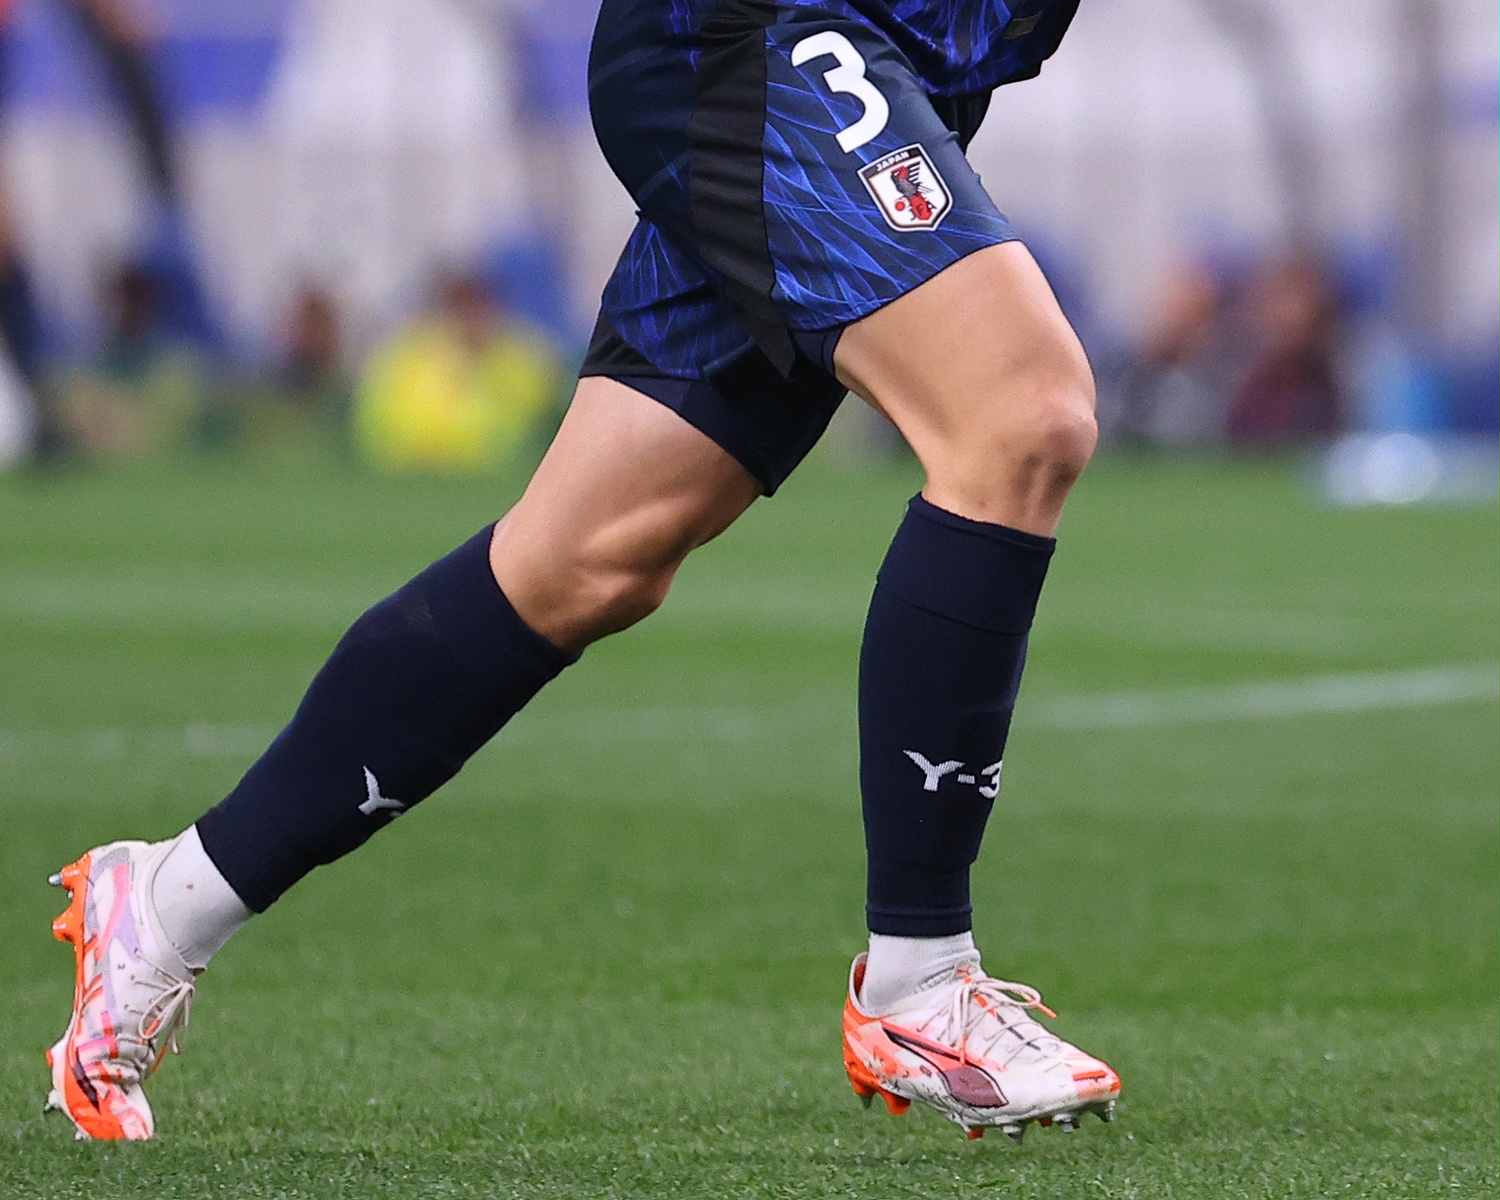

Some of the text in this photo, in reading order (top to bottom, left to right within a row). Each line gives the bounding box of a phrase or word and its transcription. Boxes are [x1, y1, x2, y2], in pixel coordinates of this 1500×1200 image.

[791, 30, 890, 154] 3
[876, 151, 910, 172] JAPAN
[902, 749, 1003, 799] Y-3
